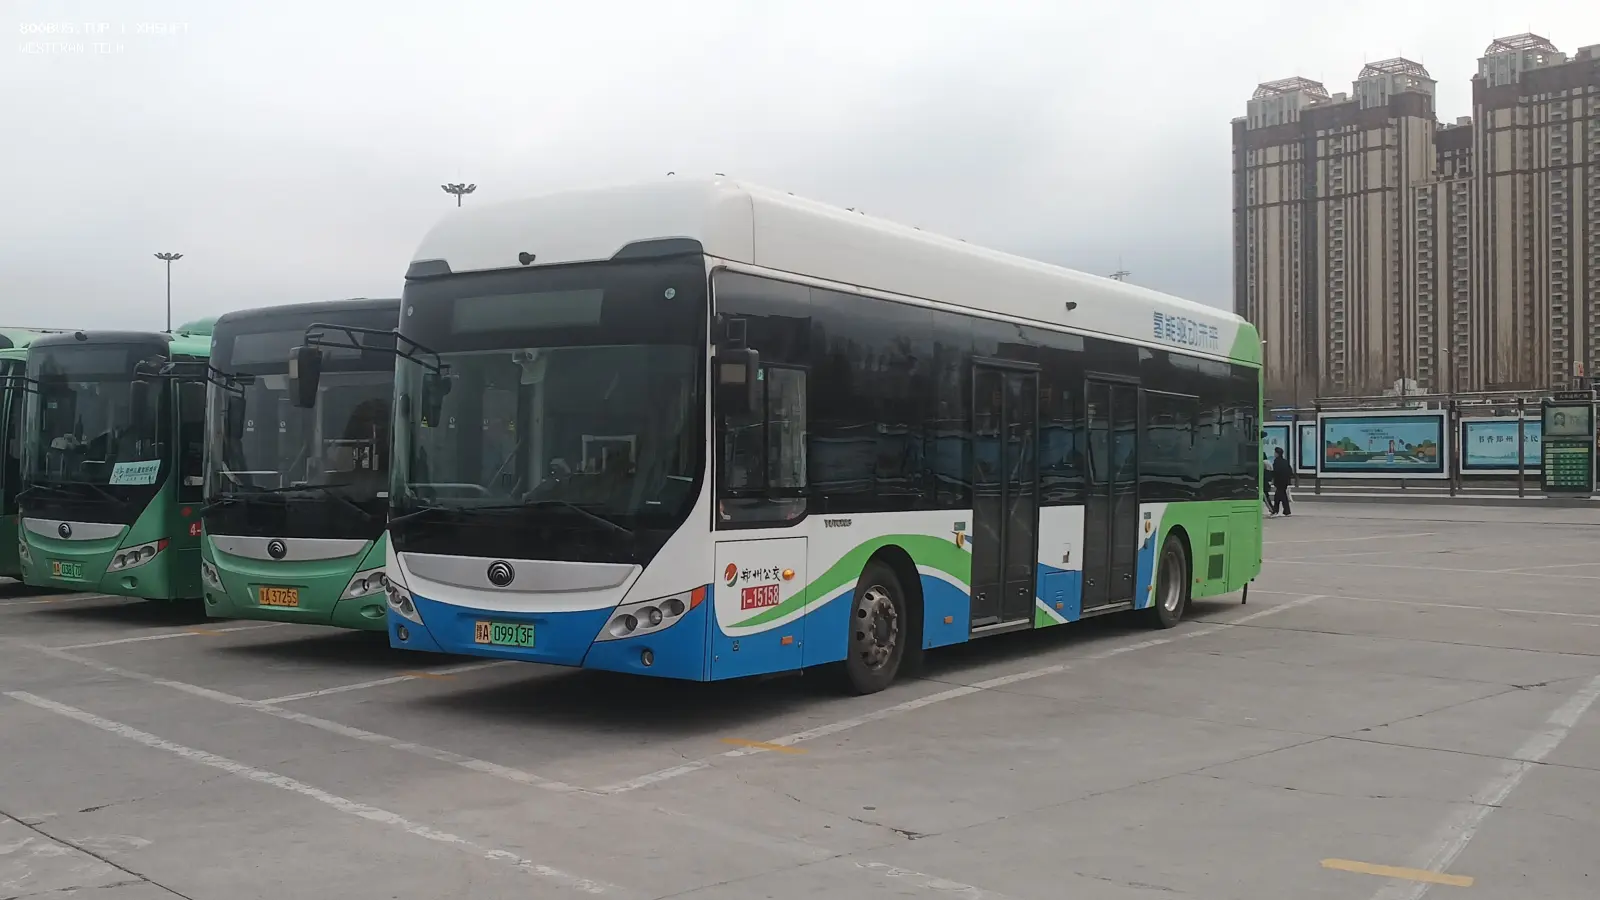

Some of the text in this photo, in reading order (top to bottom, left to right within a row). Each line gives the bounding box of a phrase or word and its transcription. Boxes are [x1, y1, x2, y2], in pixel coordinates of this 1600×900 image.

[1153, 311, 1219, 351] 氢能驱动未来
[1478, 435, 1514, 444] 书香郑州
[740, 565, 780, 583] 郑州公交
[742, 585, 779, 609] 1-15158
